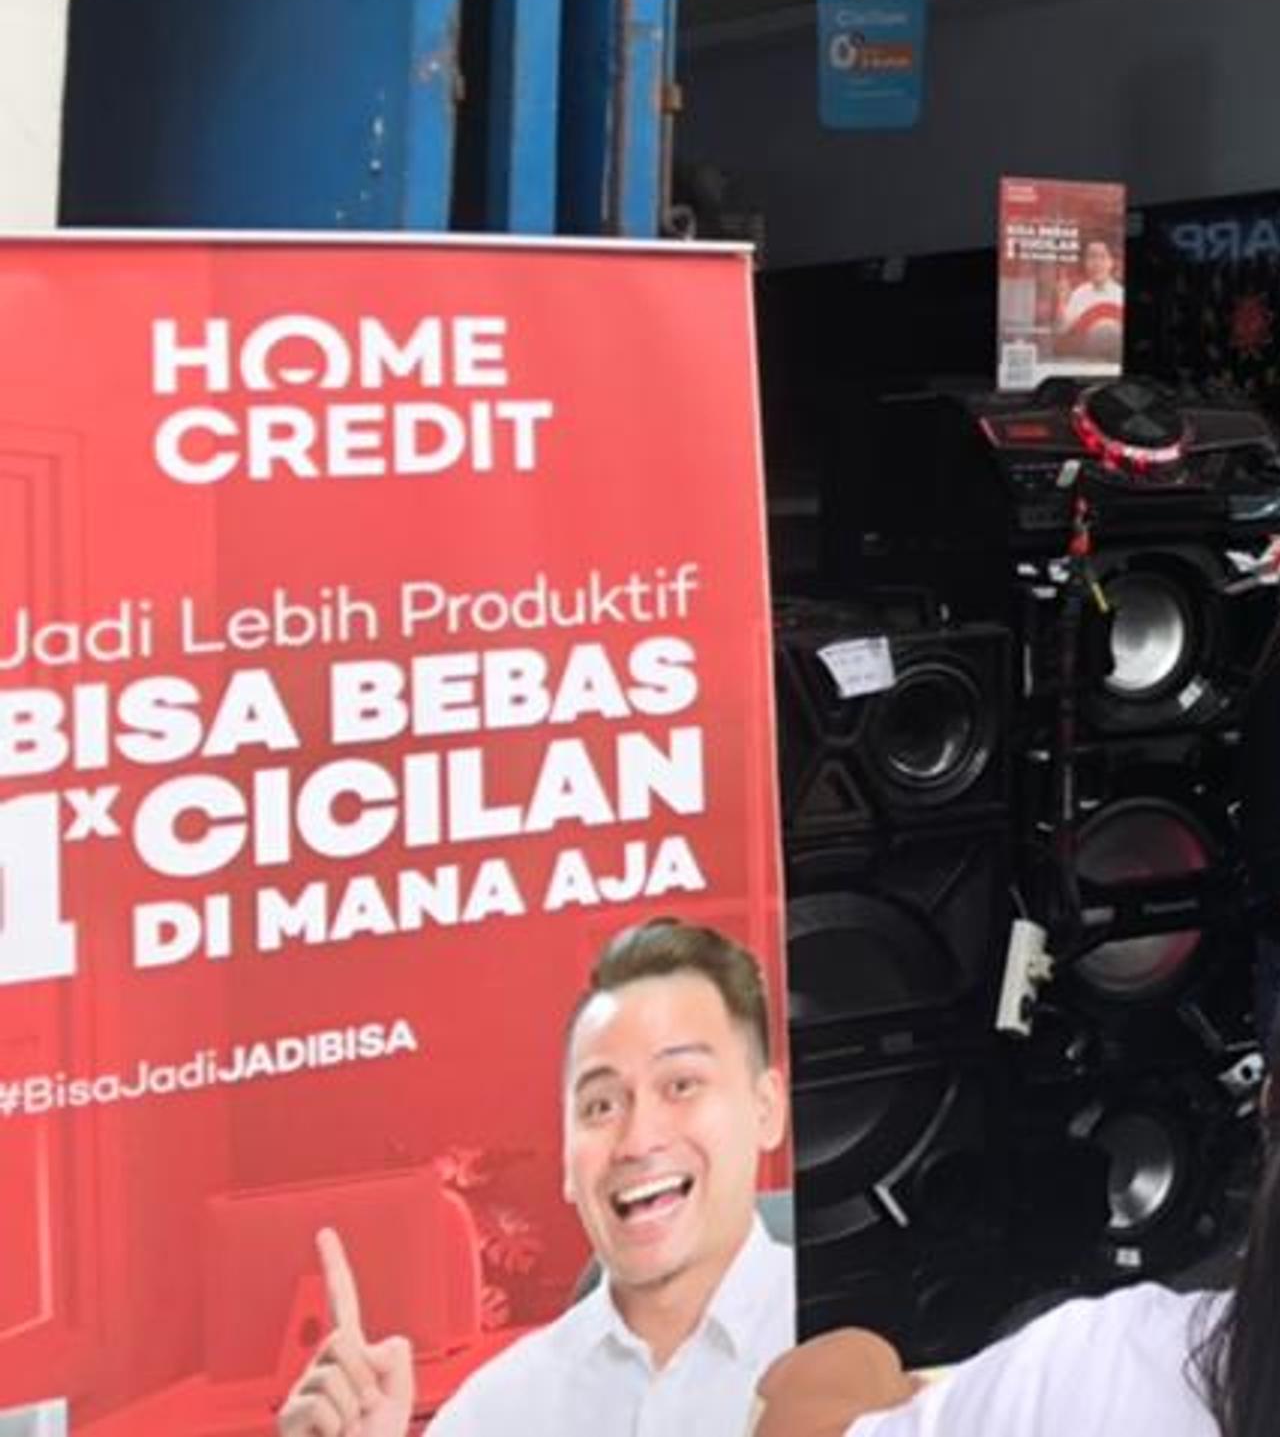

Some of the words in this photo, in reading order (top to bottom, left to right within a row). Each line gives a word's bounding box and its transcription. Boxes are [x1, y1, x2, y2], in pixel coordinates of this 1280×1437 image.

[151, 313, 510, 394] HOME
[153, 400, 554, 485] CREDIT
[0, 600, 153, 669] Jadi
[181, 585, 379, 655] Lebih
[400, 563, 698, 641] Produktif
[0, 669, 299, 779] BISA
[328, 635, 698, 745] BEBAS
[132, 725, 705, 878] CICILAN
[132, 894, 232, 970] DI
[256, 859, 525, 951] MANA
[543, 835, 706, 911] AJA
[0, 1019, 418, 1117] #BisaJadiJADIBISA
